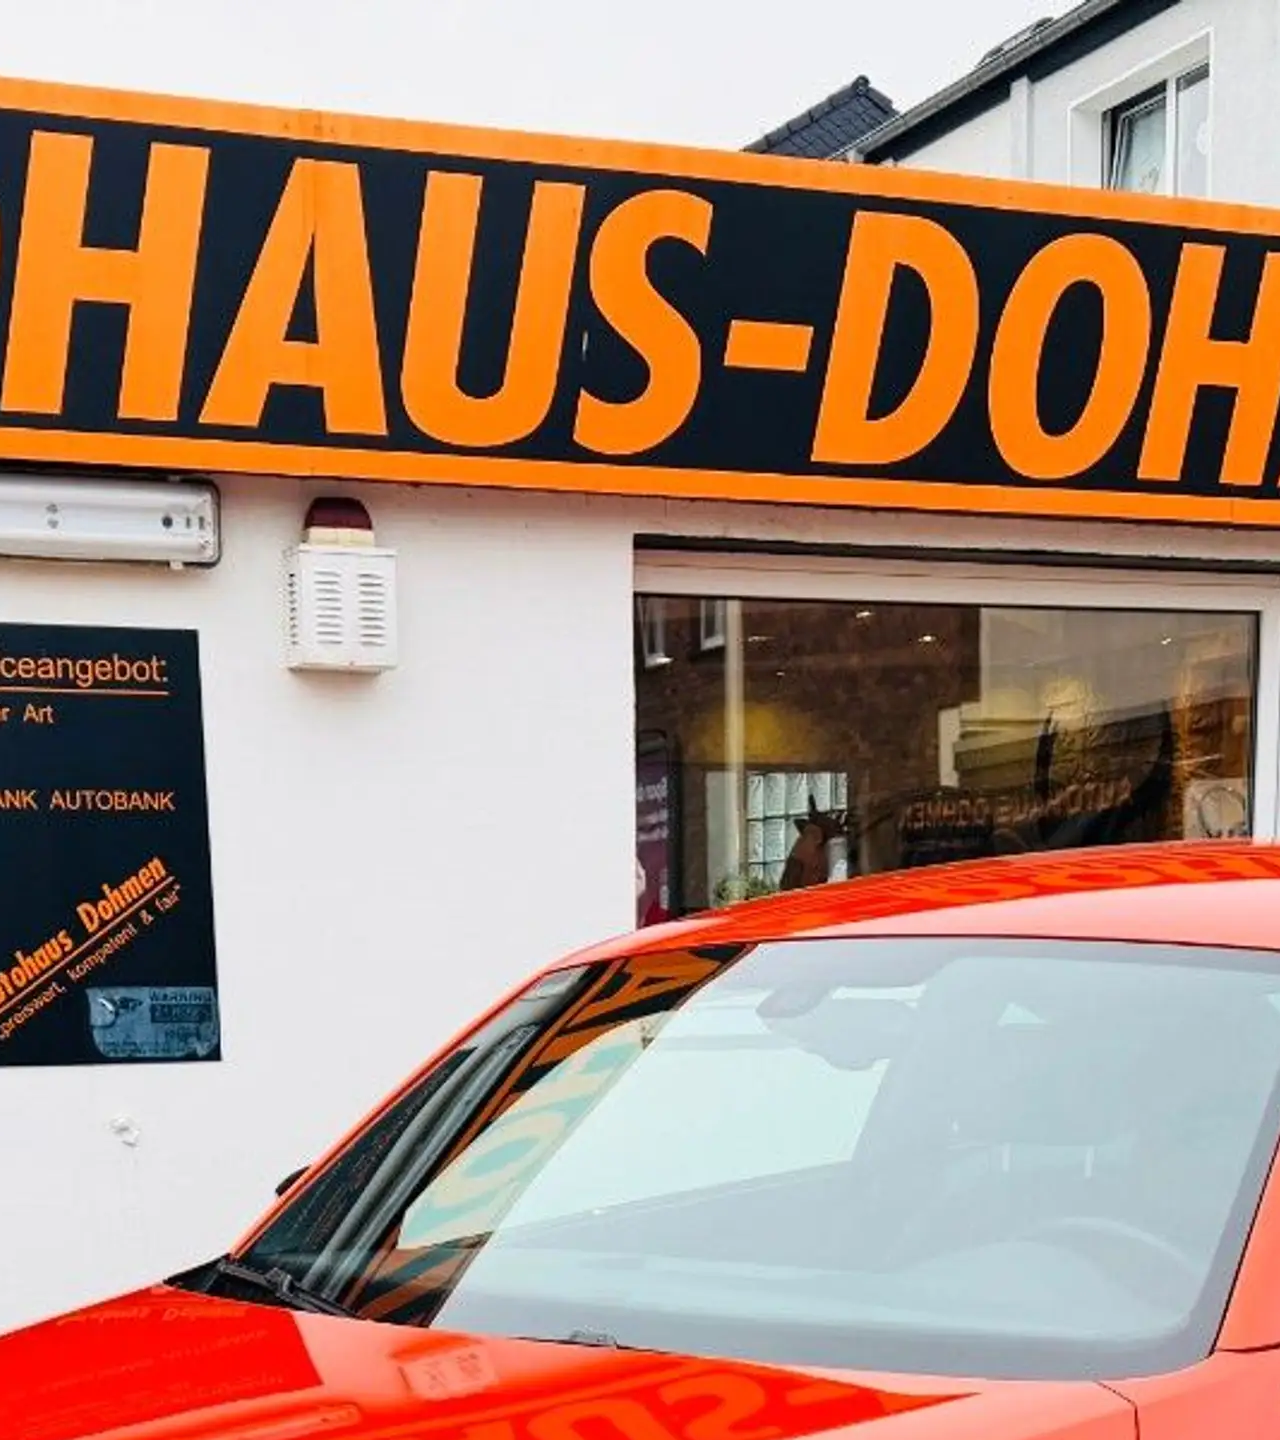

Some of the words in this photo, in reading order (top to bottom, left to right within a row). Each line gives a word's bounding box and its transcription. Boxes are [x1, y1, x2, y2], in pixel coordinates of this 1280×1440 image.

[23, 704, 54, 723] Art
[49, 790, 176, 811] AUTOBANK
[76, 857, 167, 933] Dohmen
[66, 923, 138, 984] kompetent
